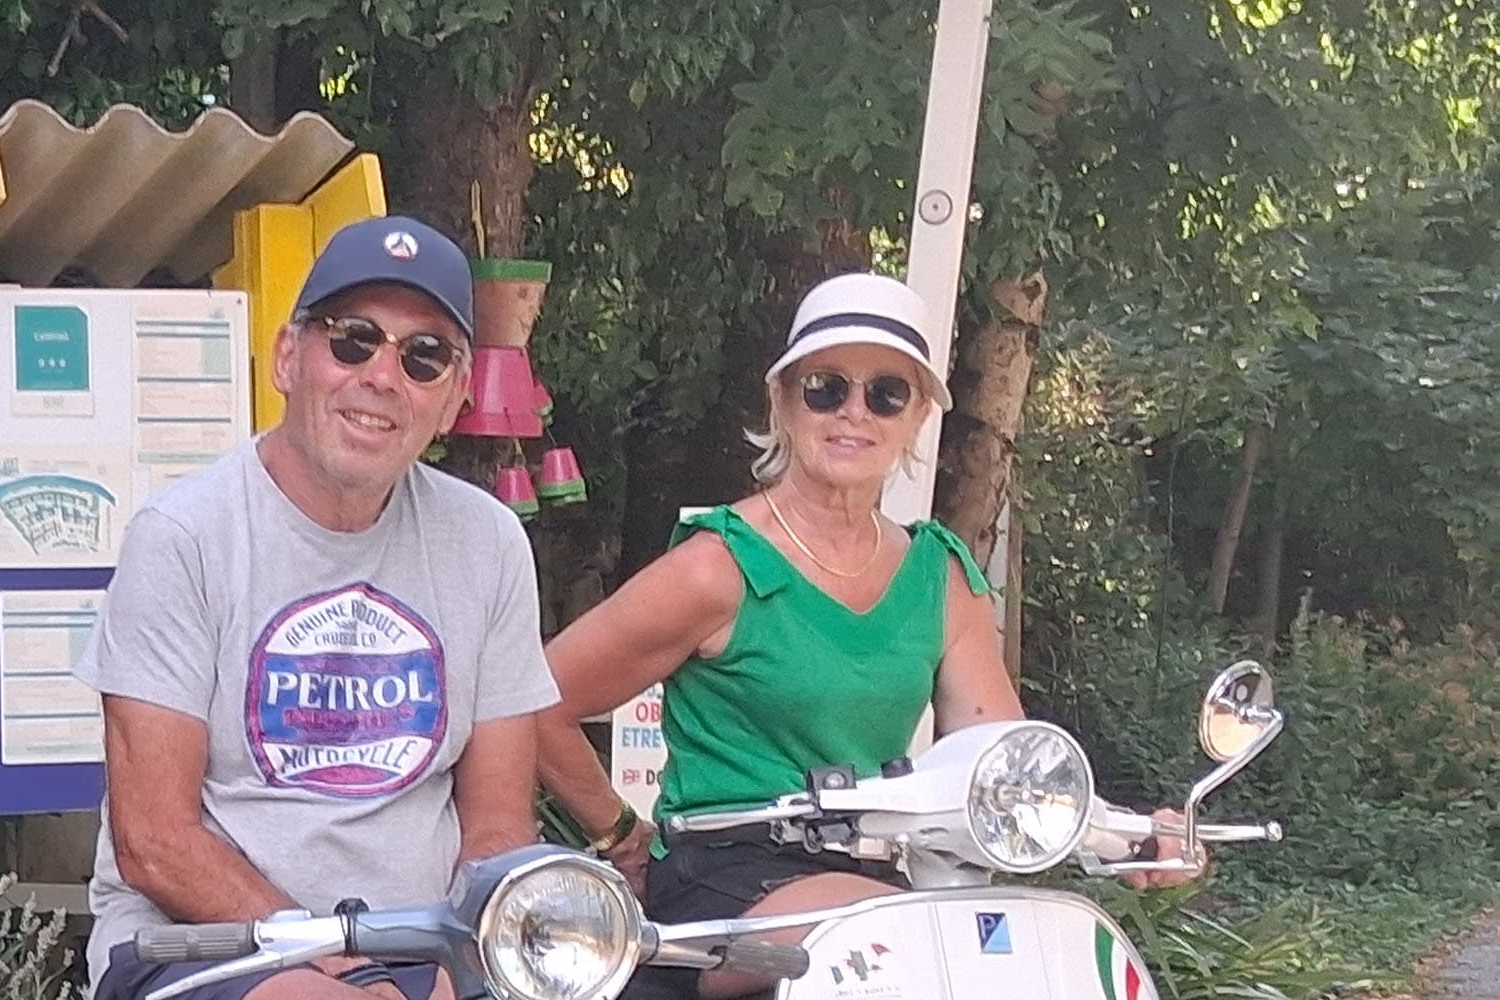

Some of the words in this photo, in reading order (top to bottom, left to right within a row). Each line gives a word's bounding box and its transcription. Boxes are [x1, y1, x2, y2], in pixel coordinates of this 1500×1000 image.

[285, 602, 347, 648] GENUINE
[266, 670, 433, 711] PETROL
[622, 727, 661, 749] ETRE
